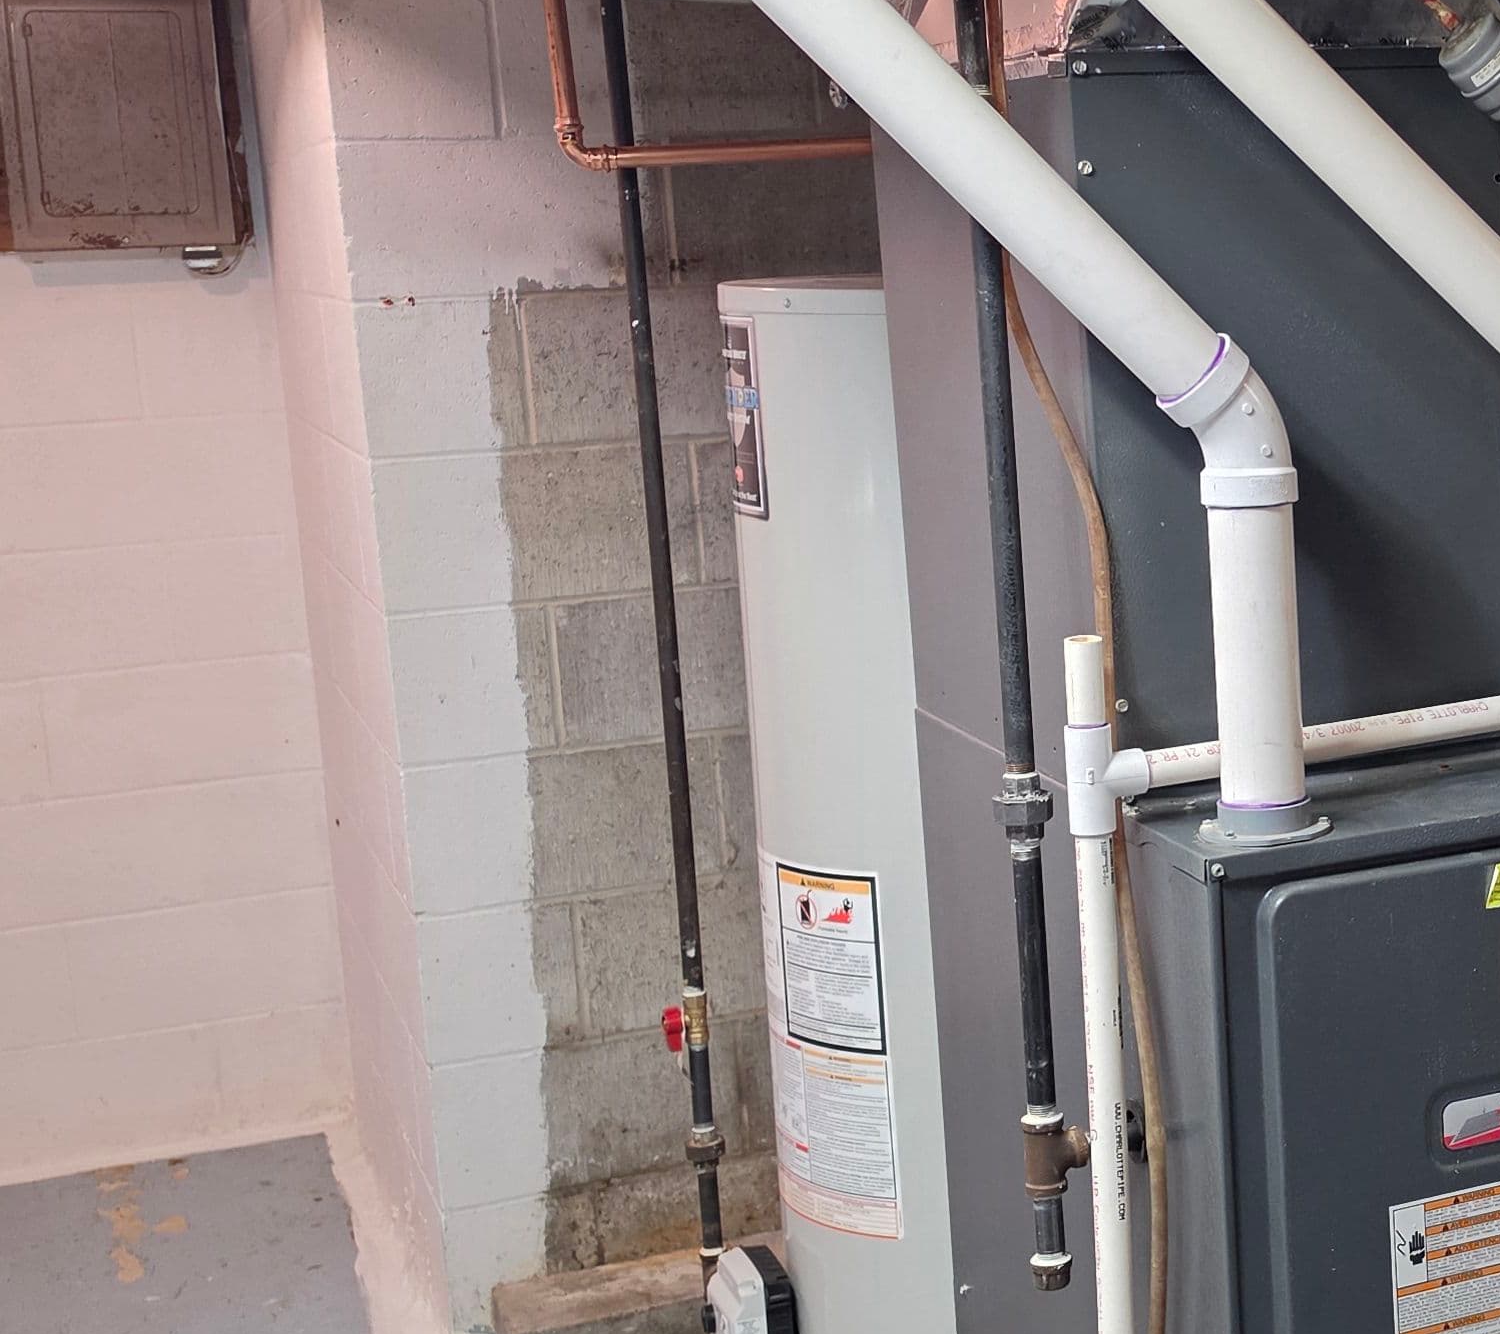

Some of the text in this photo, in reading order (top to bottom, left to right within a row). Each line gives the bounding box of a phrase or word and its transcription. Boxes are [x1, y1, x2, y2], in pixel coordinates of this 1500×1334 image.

[806, 879, 835, 890] WARNING
[1114, 1102, 1126, 1221] WWW.CHARLOTTEPIPE.COM
[1461, 1188, 1496, 1202] WARNING
